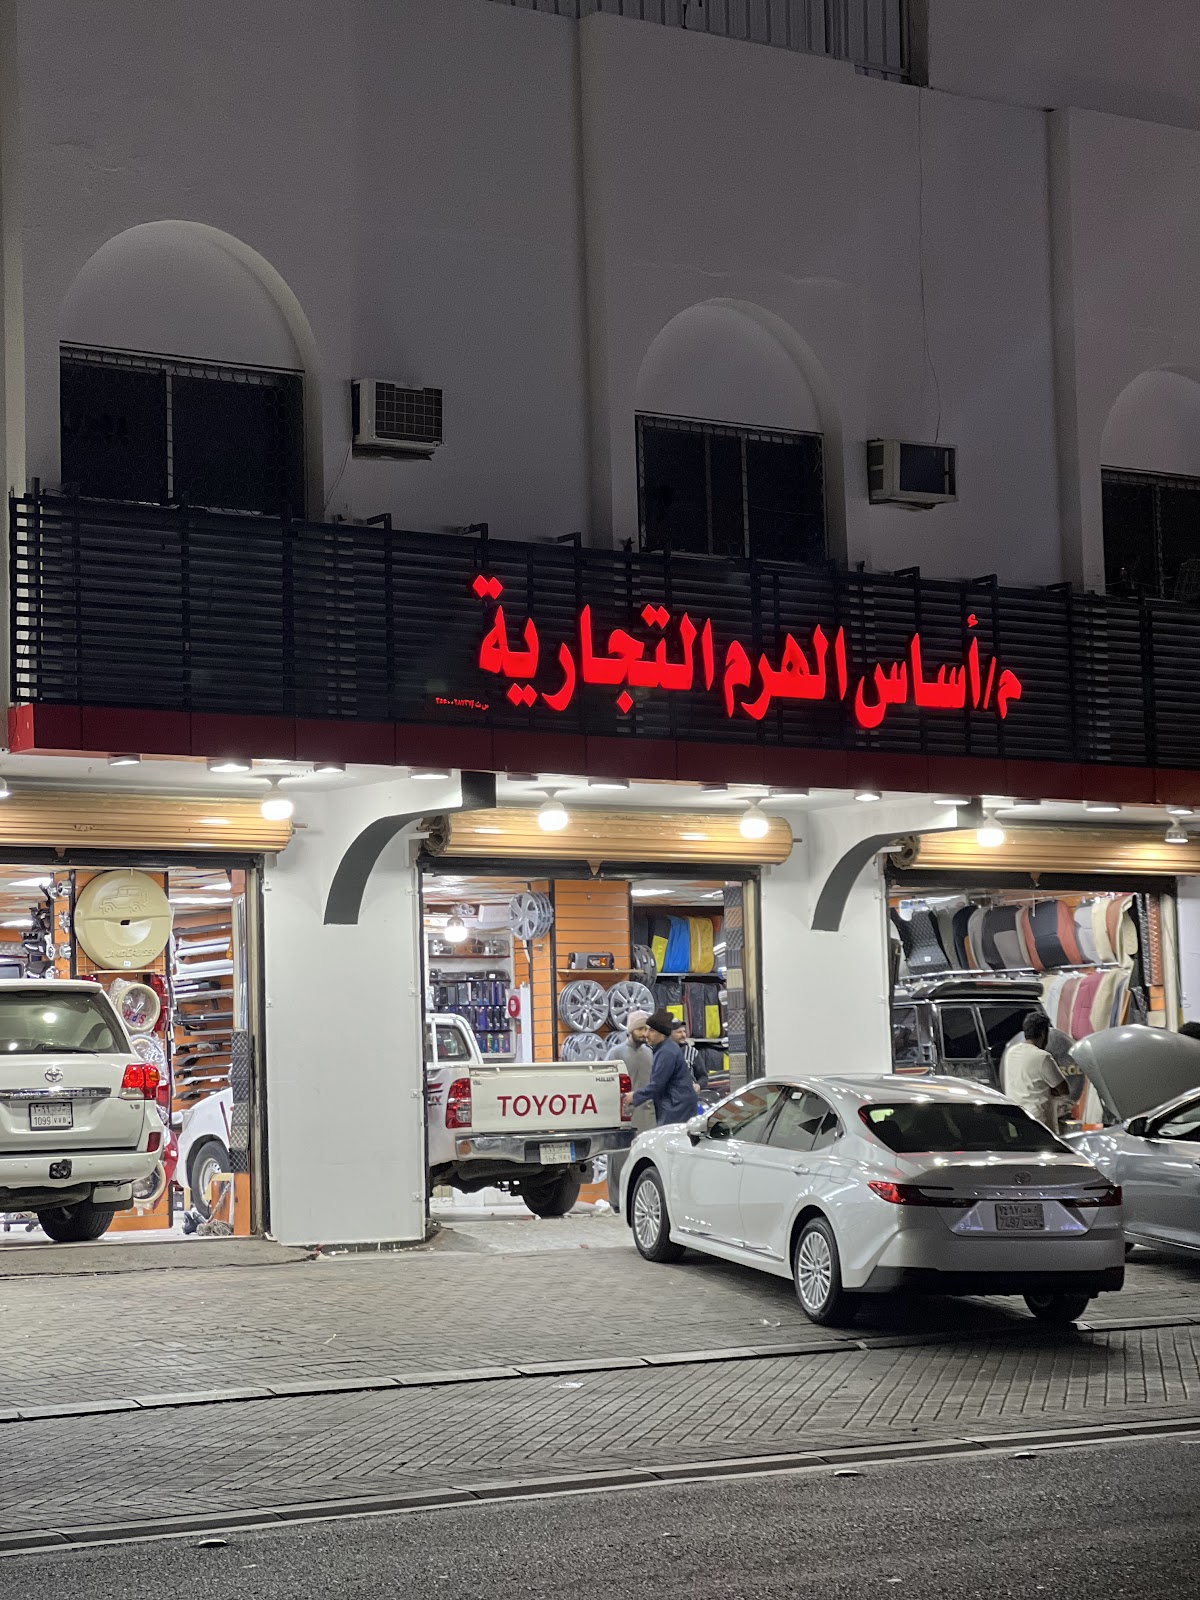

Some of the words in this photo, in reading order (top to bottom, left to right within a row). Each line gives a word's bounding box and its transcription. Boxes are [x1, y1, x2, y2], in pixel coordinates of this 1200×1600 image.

[472, 574, 714, 714] التجارية
[724, 624, 848, 720] الهرم
[34, 1116, 51, 1126] 1099
[497, 1094, 598, 1117] TOYOTA
